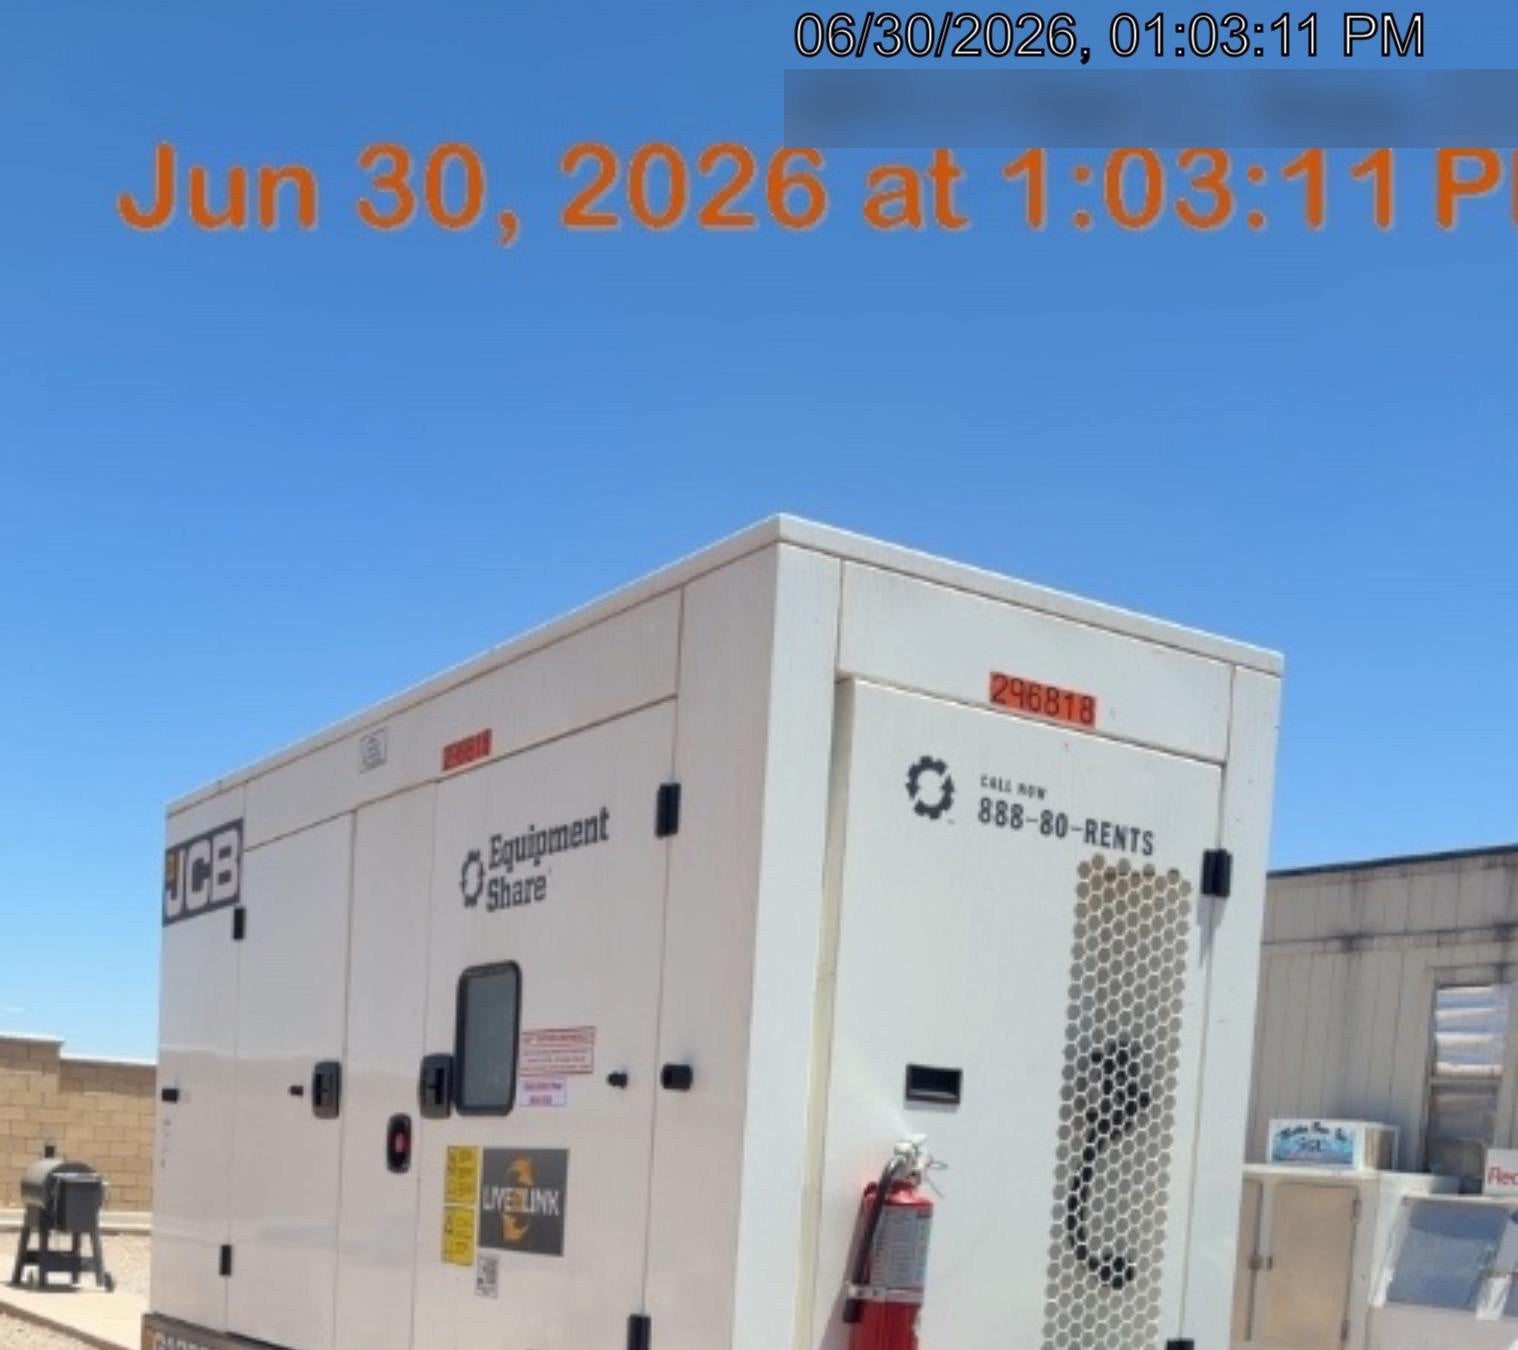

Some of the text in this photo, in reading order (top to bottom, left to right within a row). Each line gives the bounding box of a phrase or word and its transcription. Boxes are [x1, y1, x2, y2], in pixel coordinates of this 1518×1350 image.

[990, 672, 1096, 726] 296818
[979, 773, 1047, 800] CALL NOW
[488, 806, 610, 874] Equipment
[978, 797, 1154, 856] 888-80-RENTS
[165, 829, 240, 917] JCB
[485, 874, 547, 913] Share
